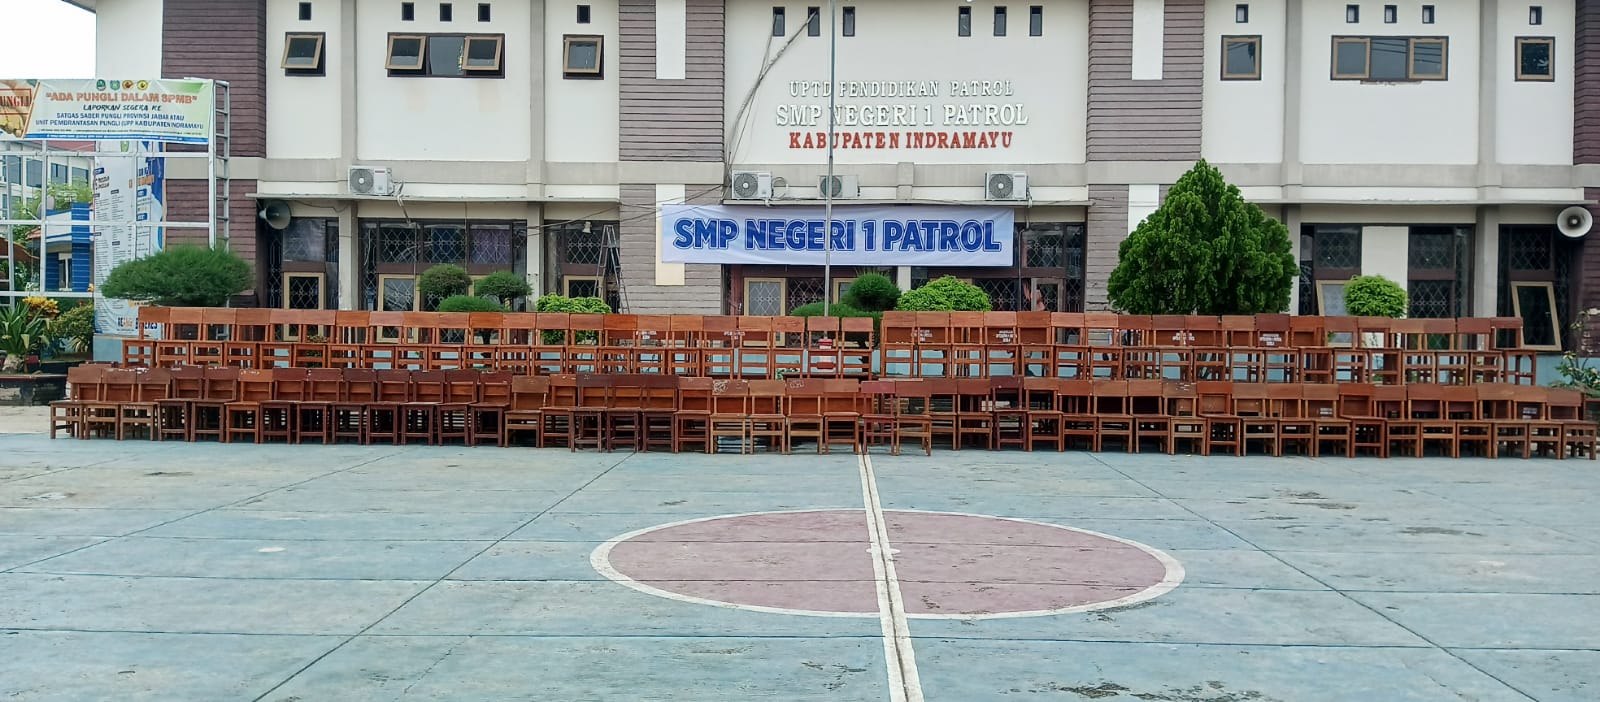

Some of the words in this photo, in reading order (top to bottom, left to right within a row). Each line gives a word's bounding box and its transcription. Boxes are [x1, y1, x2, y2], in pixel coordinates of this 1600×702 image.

[76, 92, 118, 102] PUNGLI
[121, 93, 159, 102] DALAM
[789, 81, 831, 97] UPTD
[839, 81, 938, 97] PENDIDIKAN
[951, 80, 1013, 97] PATROL
[0, 95, 30, 107] UNGLI
[83, 104, 120, 112] LAPORKAN
[776, 104, 822, 126] SMP
[828, 104, 917, 126] NEGERI
[924, 105, 934, 126] 1
[943, 103, 1029, 126] PATROL
[789, 132, 900, 149] KABUPATEN
[906, 131, 1013, 149] INDRAMAYU
[673, 218, 740, 250] SMP
[745, 219, 856, 251] NEGERI
[863, 220, 876, 251] 1
[882, 219, 1002, 252] PATROL
